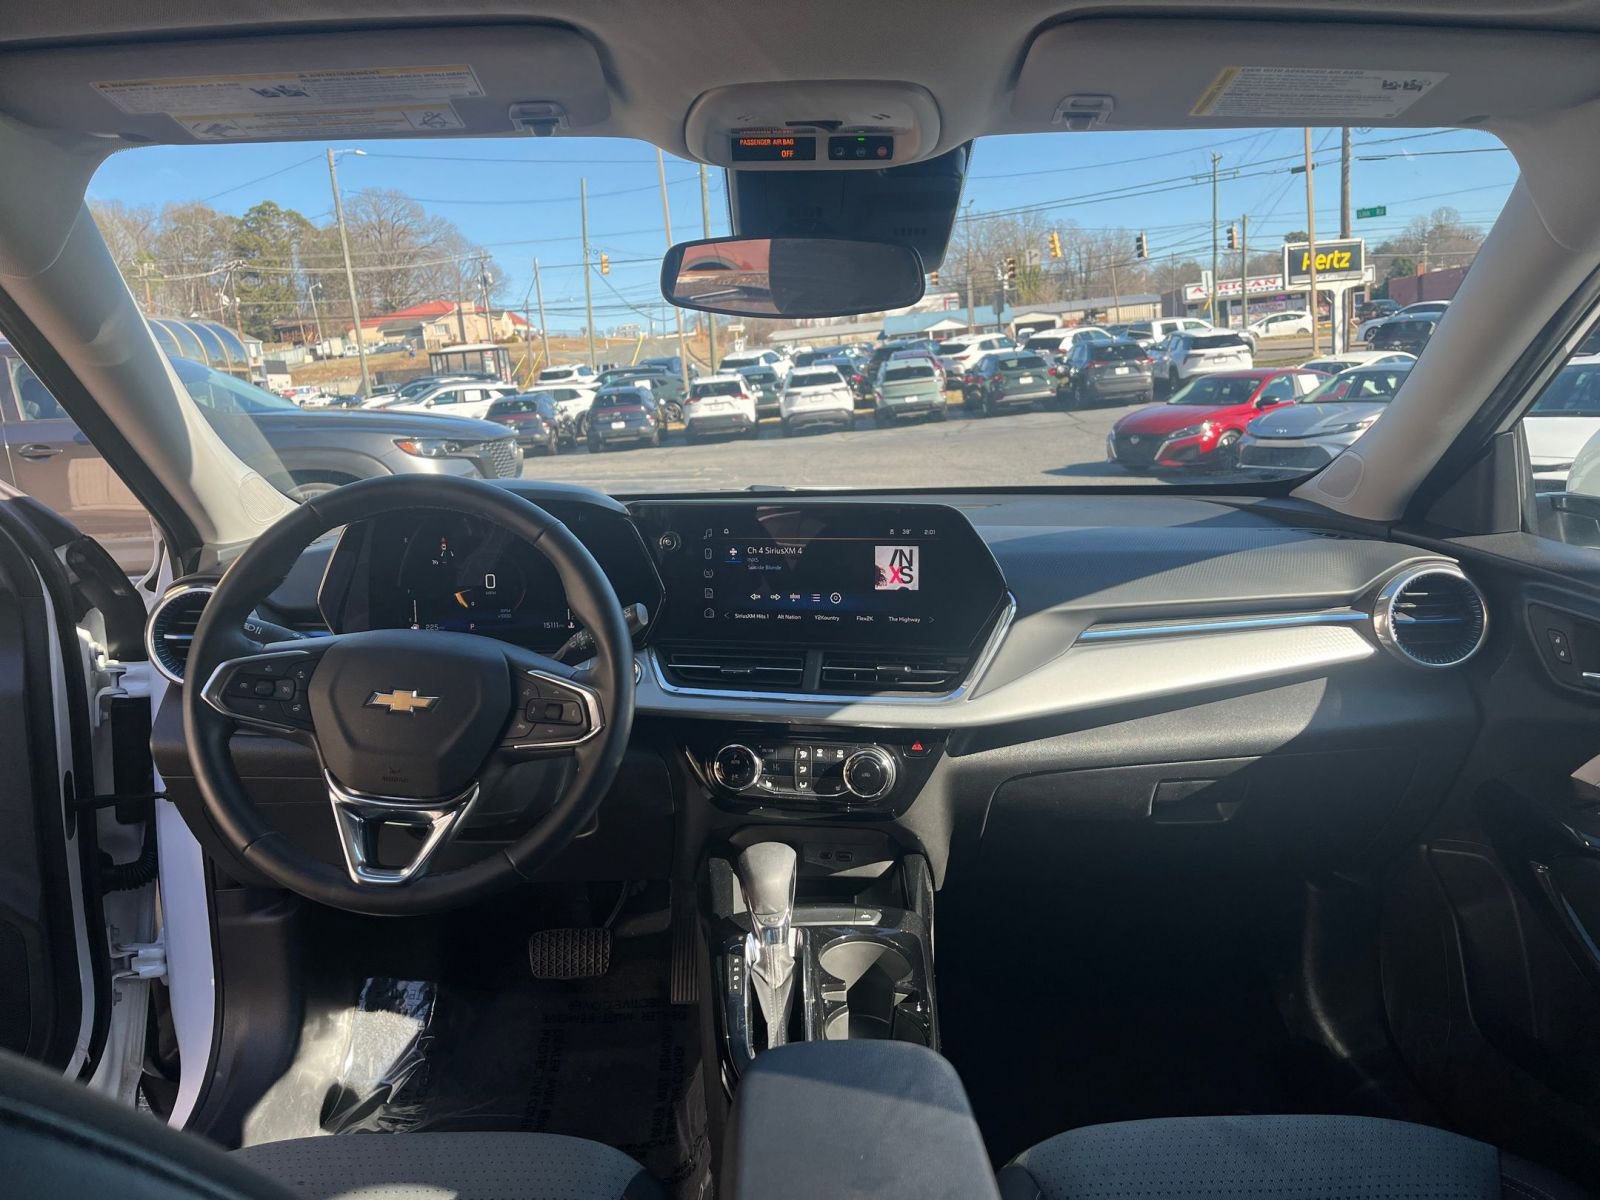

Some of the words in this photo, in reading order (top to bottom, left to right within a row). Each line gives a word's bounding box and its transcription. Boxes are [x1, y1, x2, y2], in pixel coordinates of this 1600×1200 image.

[740, 138, 771, 146] PASSENGER
[772, 138, 782, 146] AIR
[782, 138, 794, 146] BAG
[781, 150, 794, 158] OFF
[765, 547, 796, 555] SiriusXM
[485, 573, 496, 589] 0
